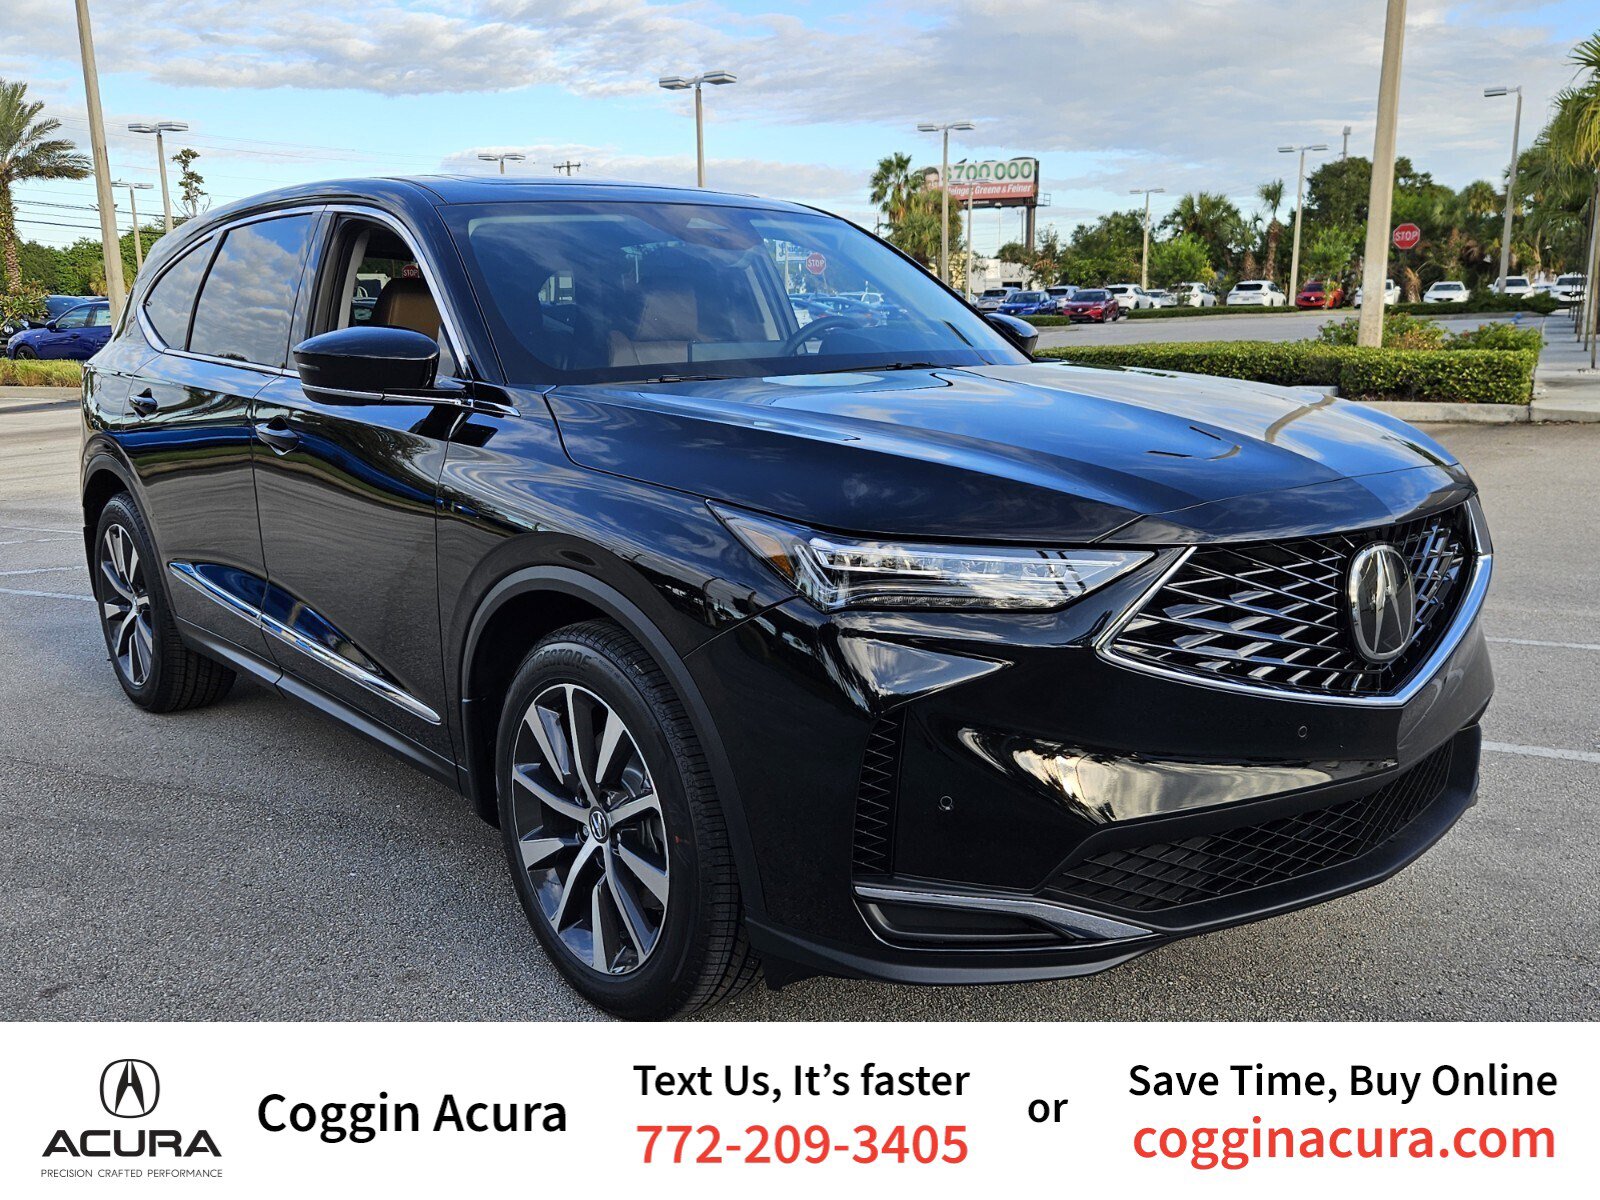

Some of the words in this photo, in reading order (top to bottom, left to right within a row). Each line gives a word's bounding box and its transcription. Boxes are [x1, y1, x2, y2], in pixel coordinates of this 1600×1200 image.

[974, 185, 1001, 195] Greene
[1007, 184, 1032, 193] Feiner
[1395, 230, 1418, 241] STOP
[807, 259, 825, 268] STOP
[403, 269, 419, 277] STOP
